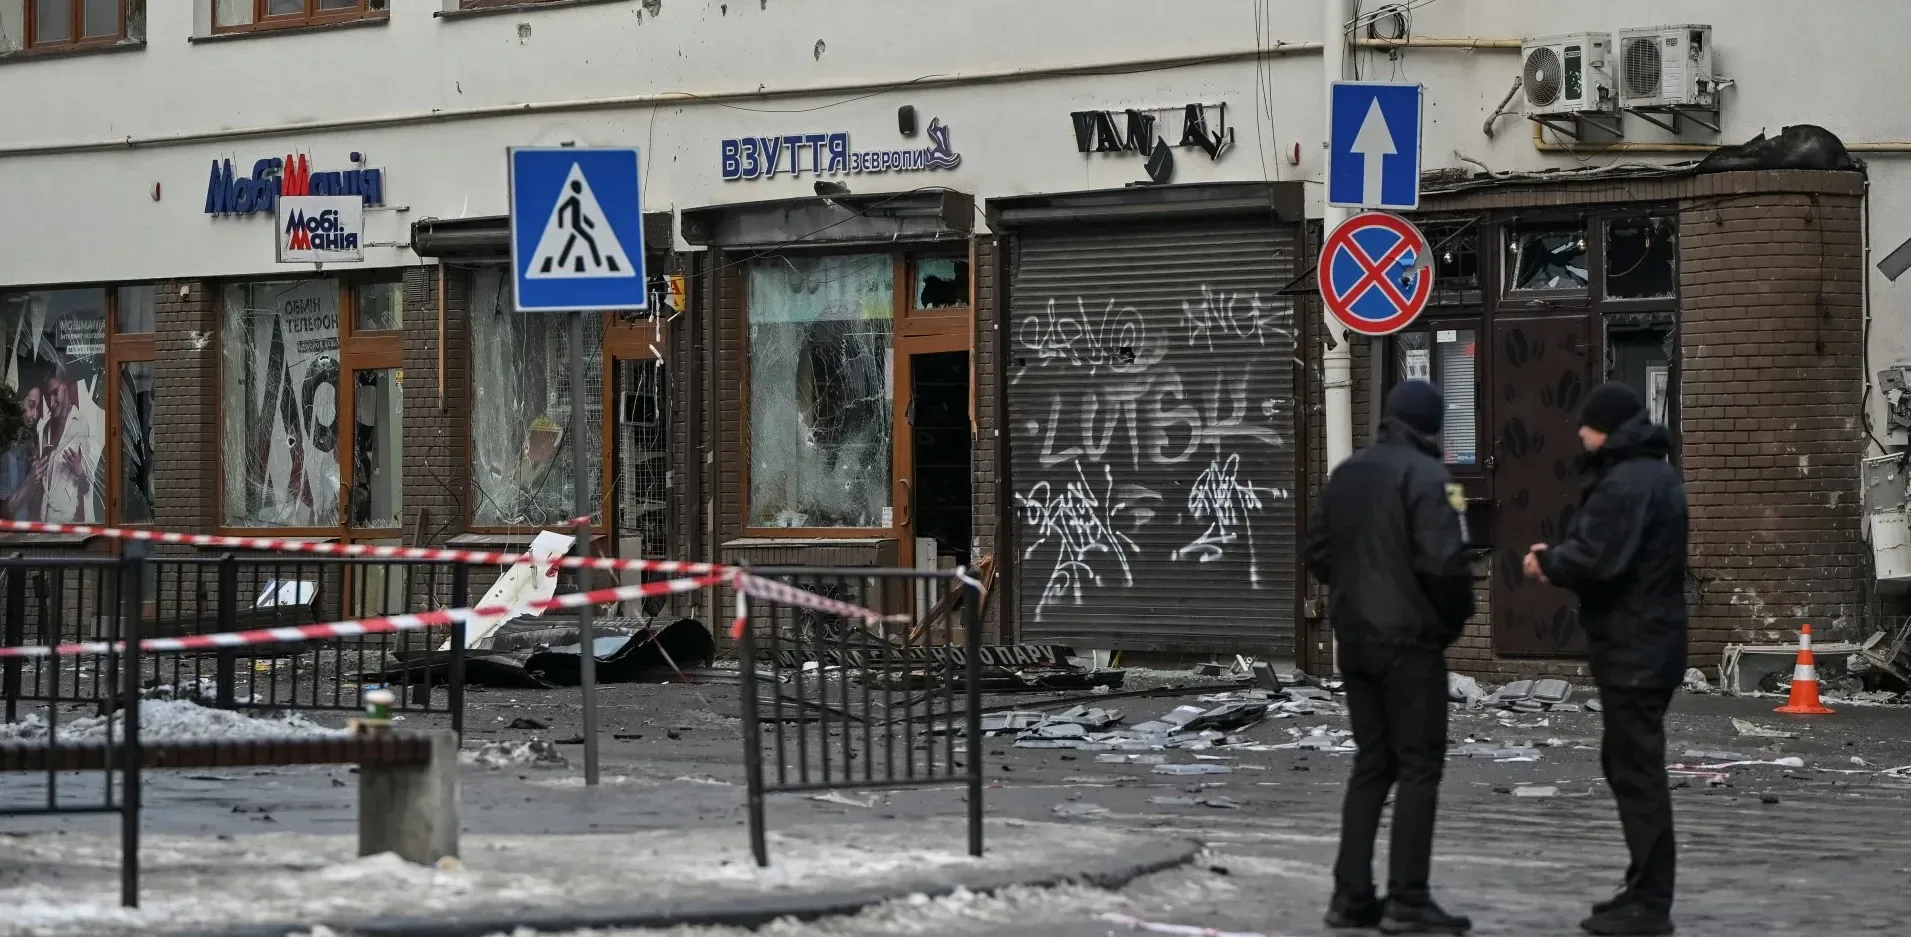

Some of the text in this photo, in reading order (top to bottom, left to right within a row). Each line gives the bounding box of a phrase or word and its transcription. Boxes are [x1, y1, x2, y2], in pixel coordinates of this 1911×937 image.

[721, 131, 849, 180] ВЗУТТЯ
[286, 208, 339, 234] Мобі
[288, 226, 358, 250] Манія
[285, 297, 320, 315] ОБМІН
[994, 645, 1057, 665] ПАРУ
